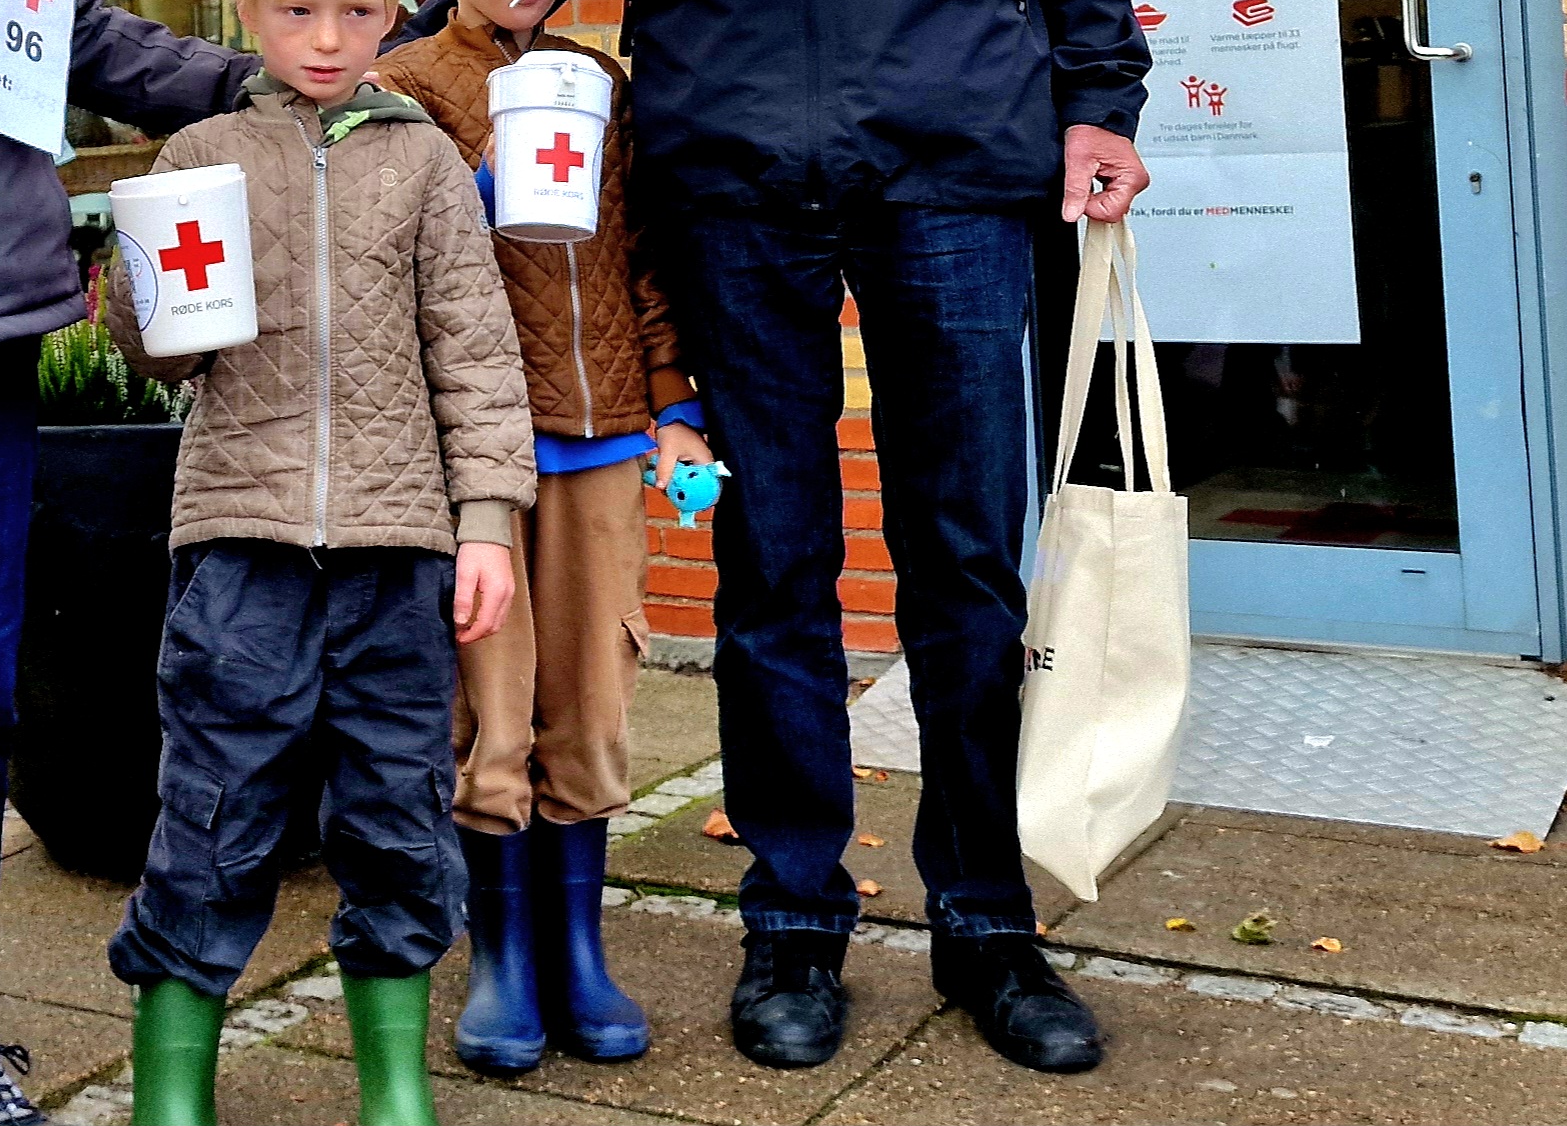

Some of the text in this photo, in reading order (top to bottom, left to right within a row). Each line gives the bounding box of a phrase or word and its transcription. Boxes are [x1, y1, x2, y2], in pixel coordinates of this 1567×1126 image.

[5, 18, 44, 63] 96
[1151, 206, 1177, 217] fordi
[1178, 206, 1192, 216] du
[1193, 207, 1204, 216] er
[170, 297, 235, 317] RØDE KORS
